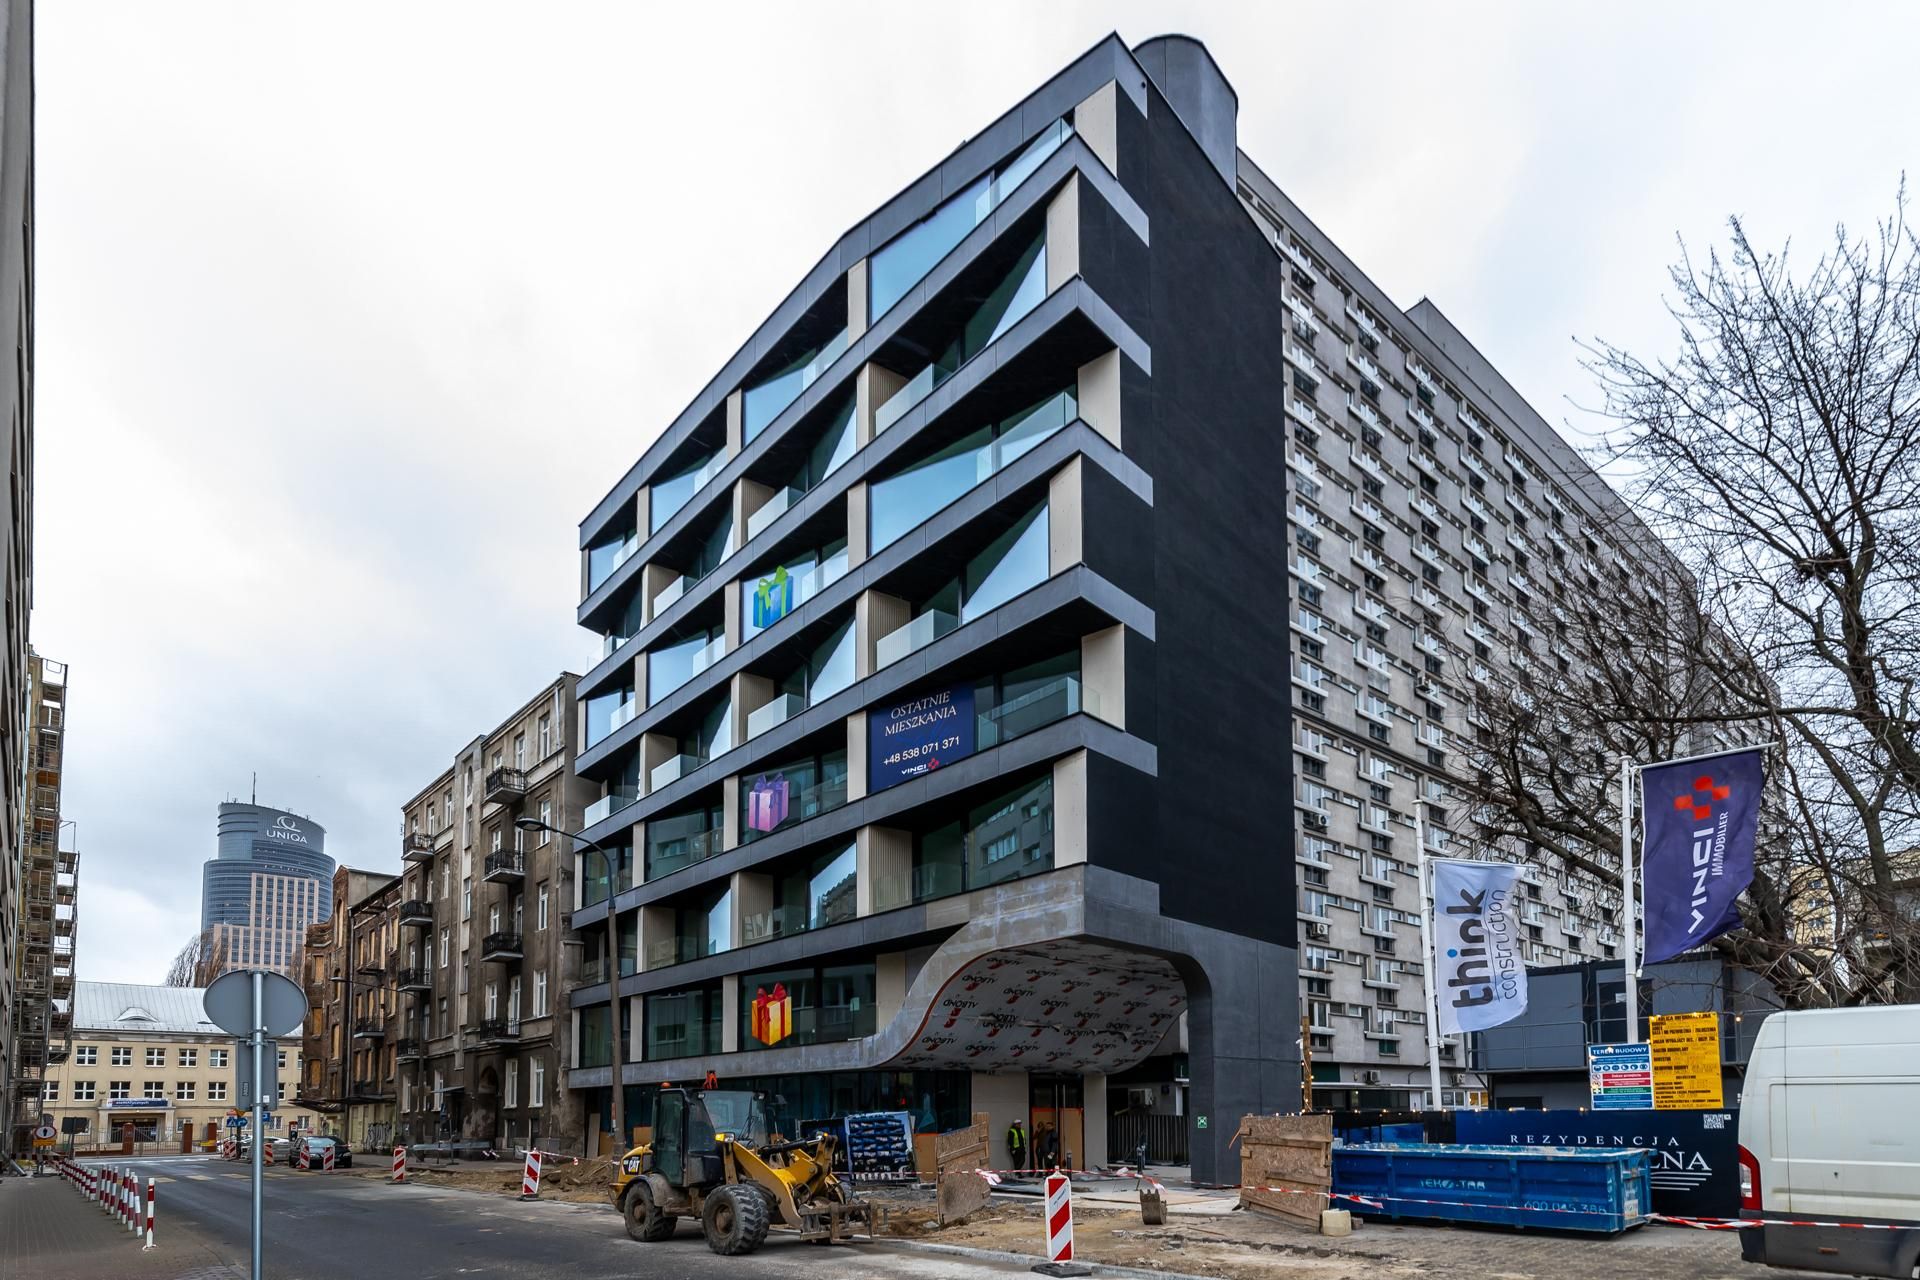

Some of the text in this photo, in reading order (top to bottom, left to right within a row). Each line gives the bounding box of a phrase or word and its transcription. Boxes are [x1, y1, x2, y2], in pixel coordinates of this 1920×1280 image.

[890, 691, 951, 719] OSTATNIE
[884, 705, 957, 736] MIESZKANIA
[883, 736, 960, 766] +48 538 071 371
[901, 763, 928, 776] VINCI
[266, 829, 308, 844] UNIQA
[1711, 811, 1730, 876] IMMOBILIER
[1687, 825, 1715, 935] VINCI
[1446, 888, 1496, 1009] think
[1489, 888, 1518, 1001] construction
[943, 999, 978, 1008] ALBOND
[1510, 1134, 1680, 1147] REZYDENCJA
[628, 1160, 640, 1172] CAT
